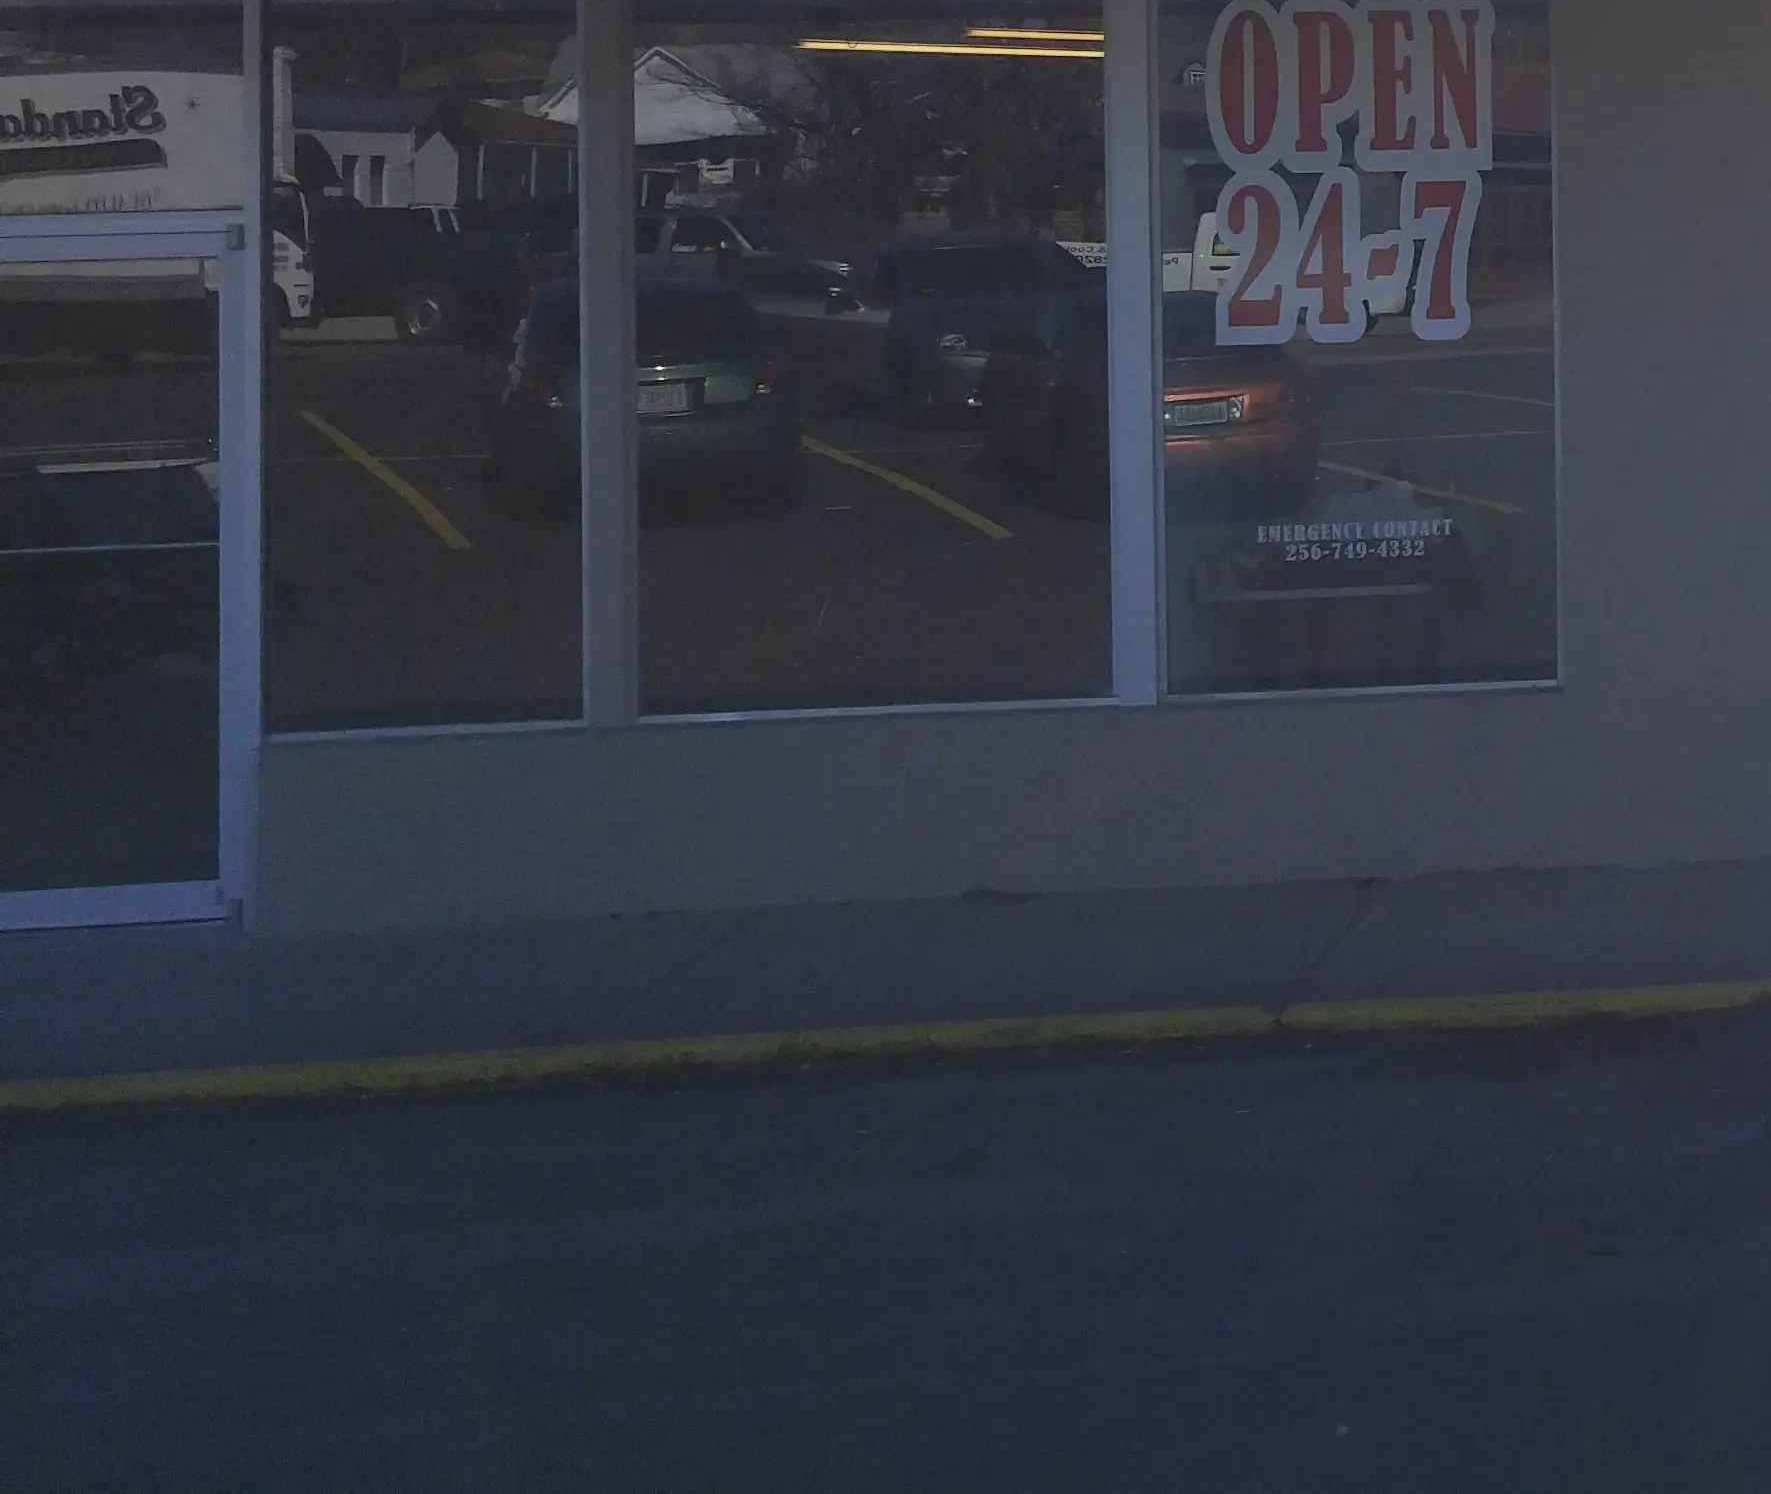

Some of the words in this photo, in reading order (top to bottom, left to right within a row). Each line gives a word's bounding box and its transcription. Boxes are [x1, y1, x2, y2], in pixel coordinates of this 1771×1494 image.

[1217, 8, 1481, 156] OPEN
[1226, 180, 1468, 328] 24-7
[1257, 522, 1364, 544] EMERGENCY
[1373, 518, 1453, 538] CONTACT
[1285, 540, 1426, 562] 256-749-4332
